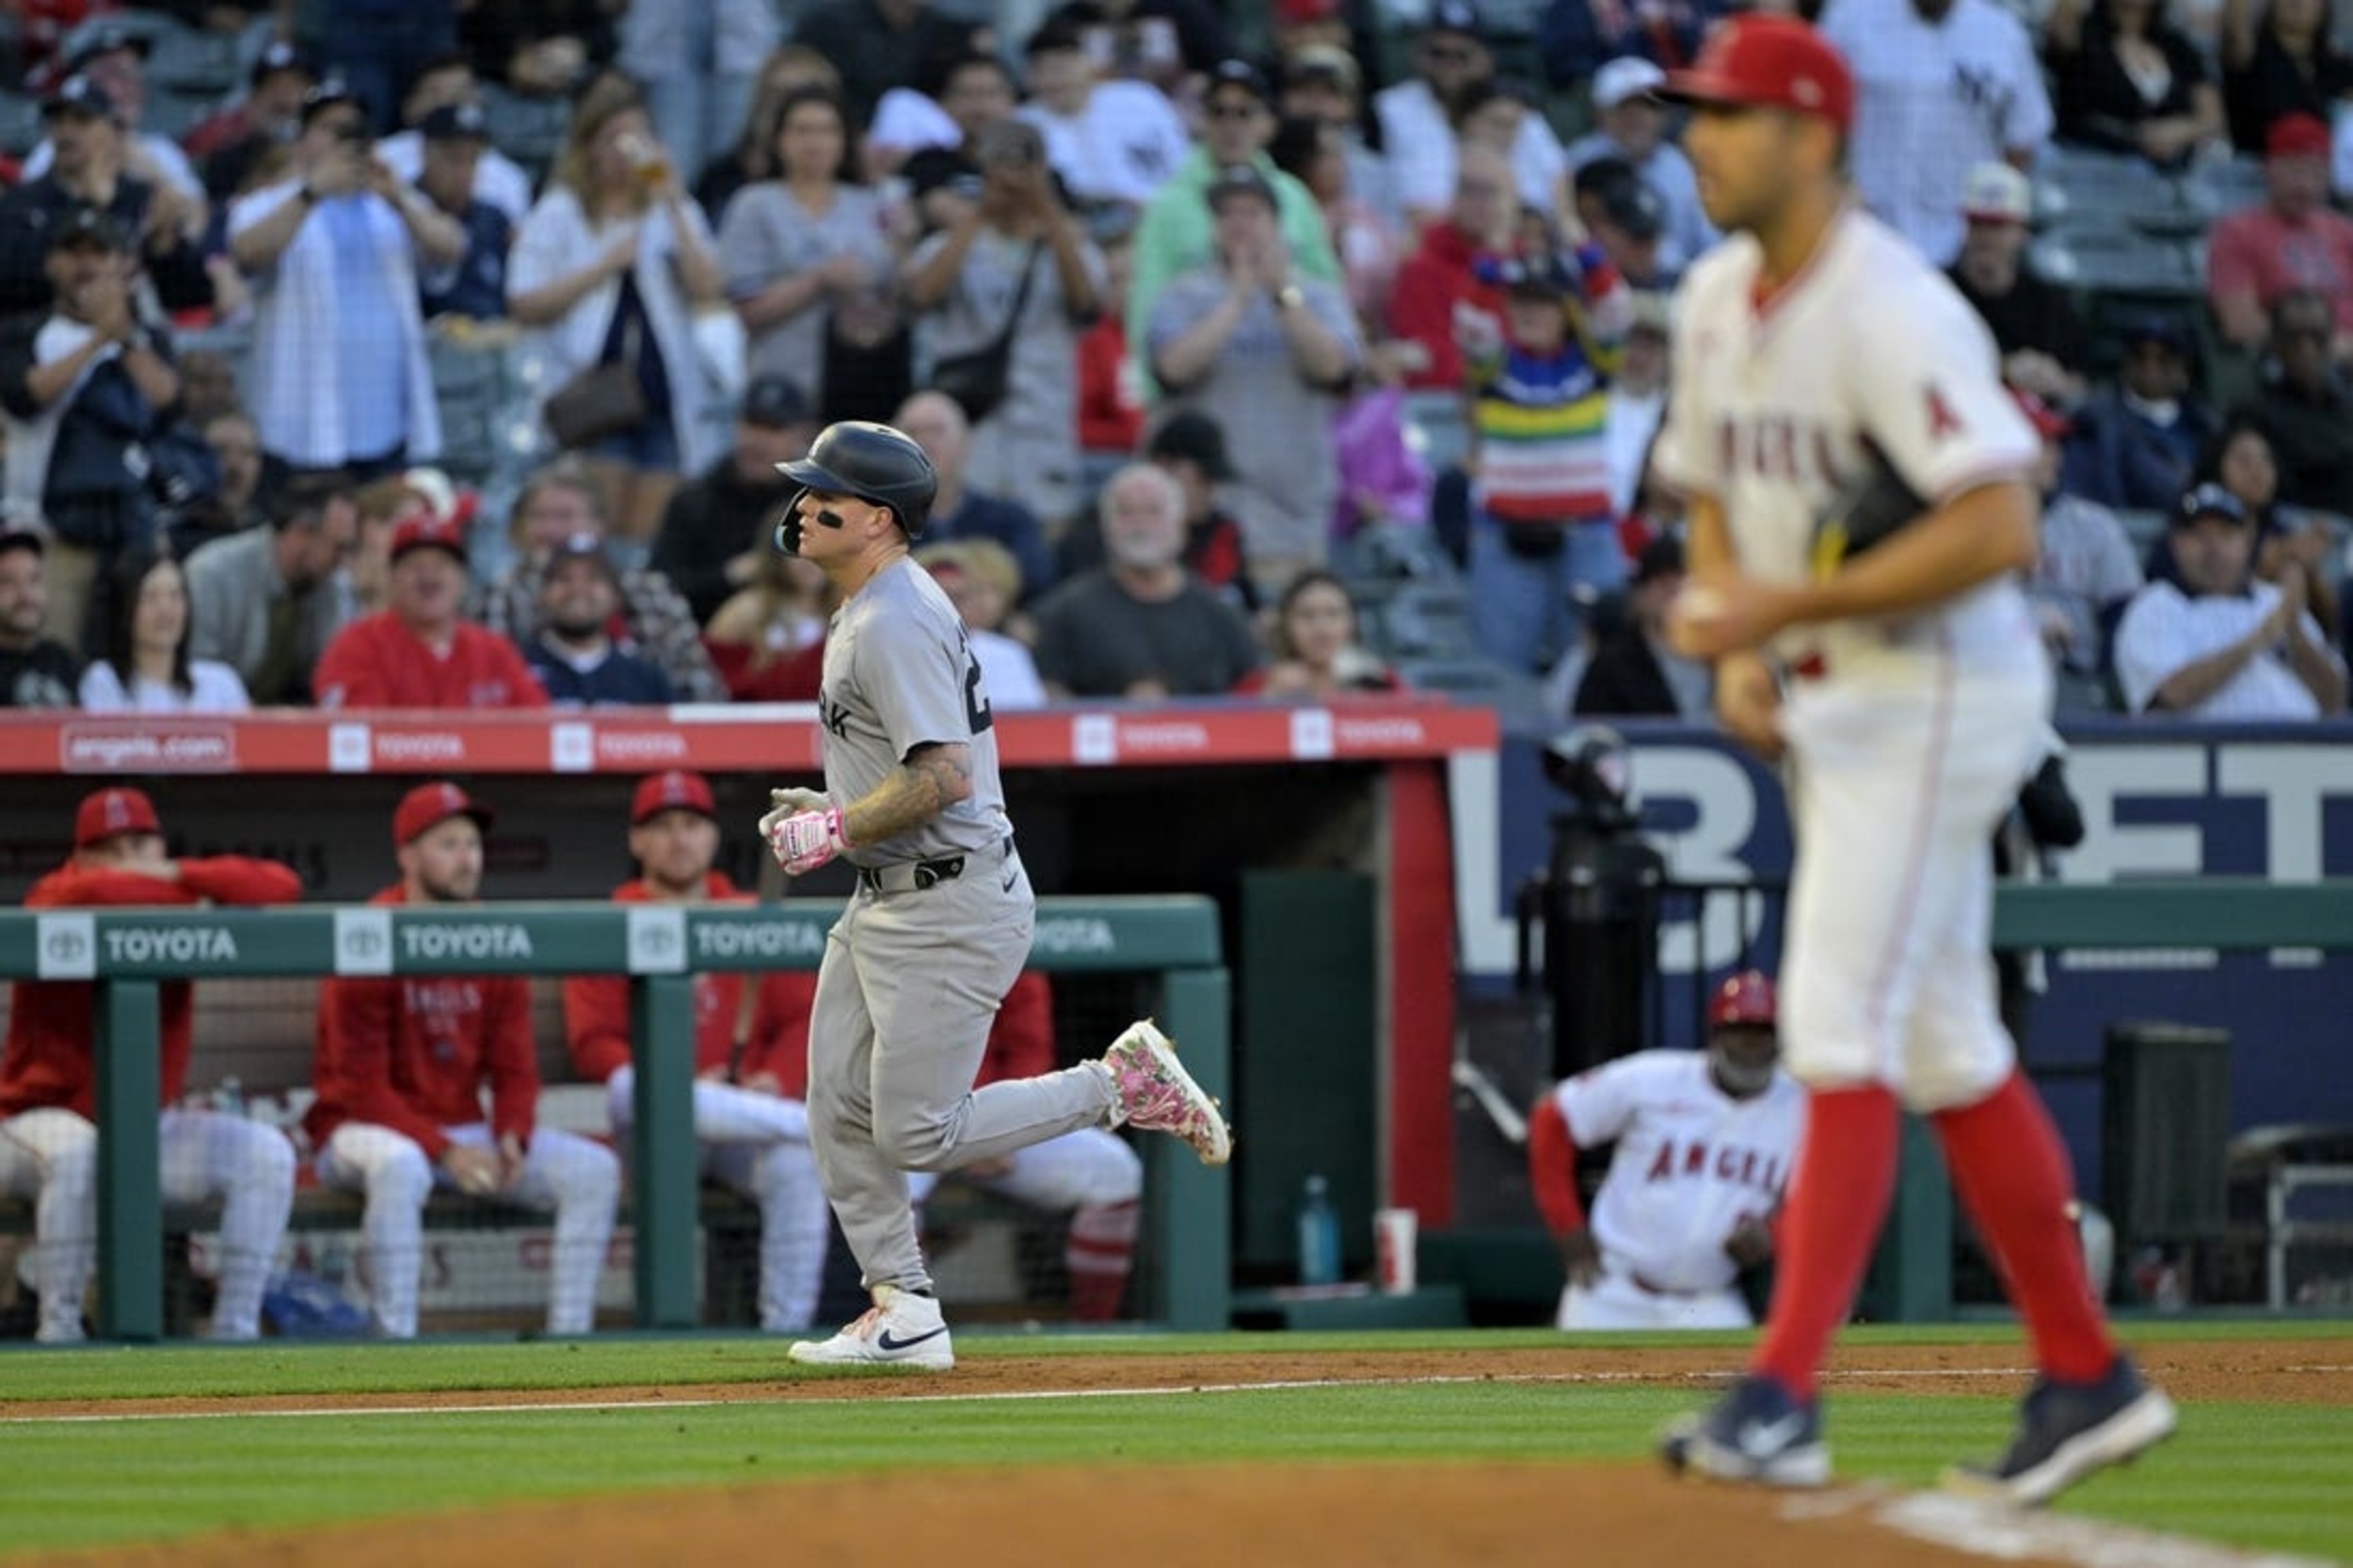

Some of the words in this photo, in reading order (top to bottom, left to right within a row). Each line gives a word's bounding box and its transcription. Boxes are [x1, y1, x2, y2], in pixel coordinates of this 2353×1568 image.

[376, 733, 465, 758] TOYOTA
[598, 733, 687, 757] TOYOTA
[1122, 723, 1208, 749] TOYOTA
[1337, 717, 1424, 744] TOYOTA
[72, 733, 226, 767] angels.com
[104, 925, 238, 962] TOYOTA
[400, 922, 534, 959] TOYOTA
[694, 921, 825, 957] TOYOTA
